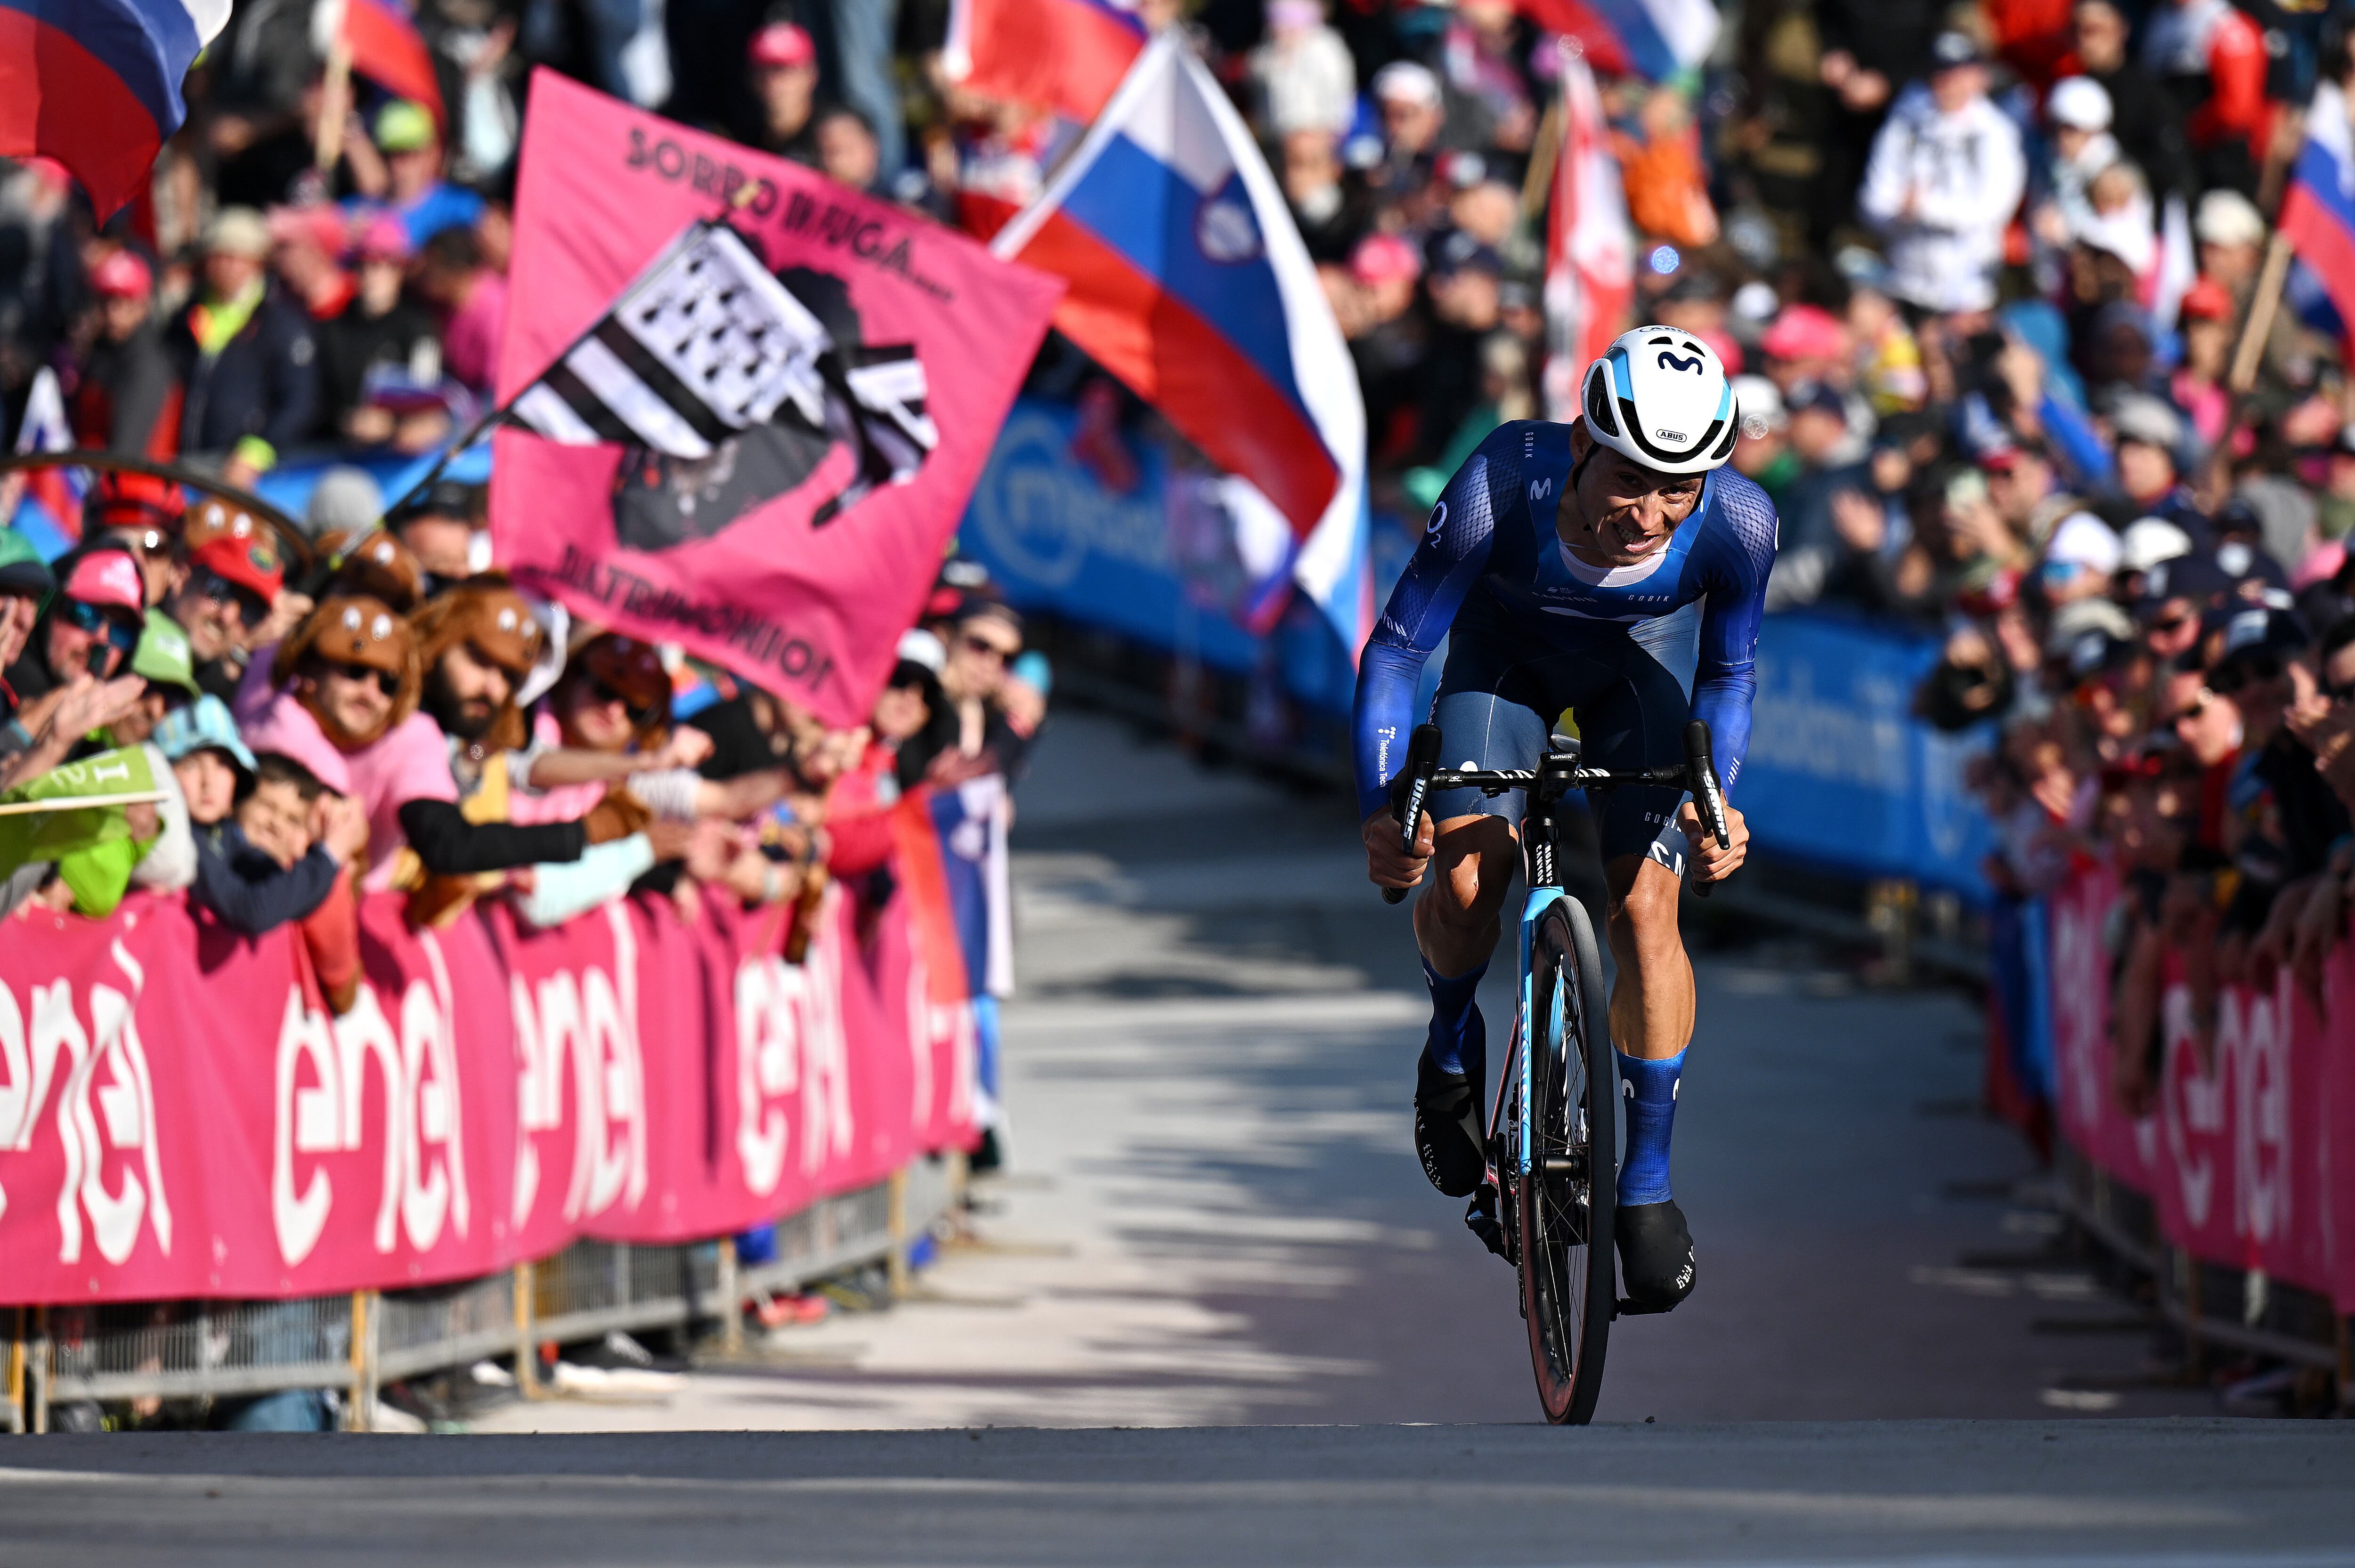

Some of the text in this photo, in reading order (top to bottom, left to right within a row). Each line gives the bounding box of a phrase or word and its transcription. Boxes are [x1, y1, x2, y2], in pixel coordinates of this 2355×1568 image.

[1525, 432, 1534, 458] GOBIK
[1660, 431, 1683, 440] ABUS
[1379, 739, 1390, 787] Telefónica Tech
[1403, 778, 1426, 840] SRAM
[1536, 844, 1544, 884] CANYON
[1544, 844, 1553, 884] CANYON
[272, 928, 470, 1268] enel
[1423, 1144, 1441, 1189] fi'zi:k
